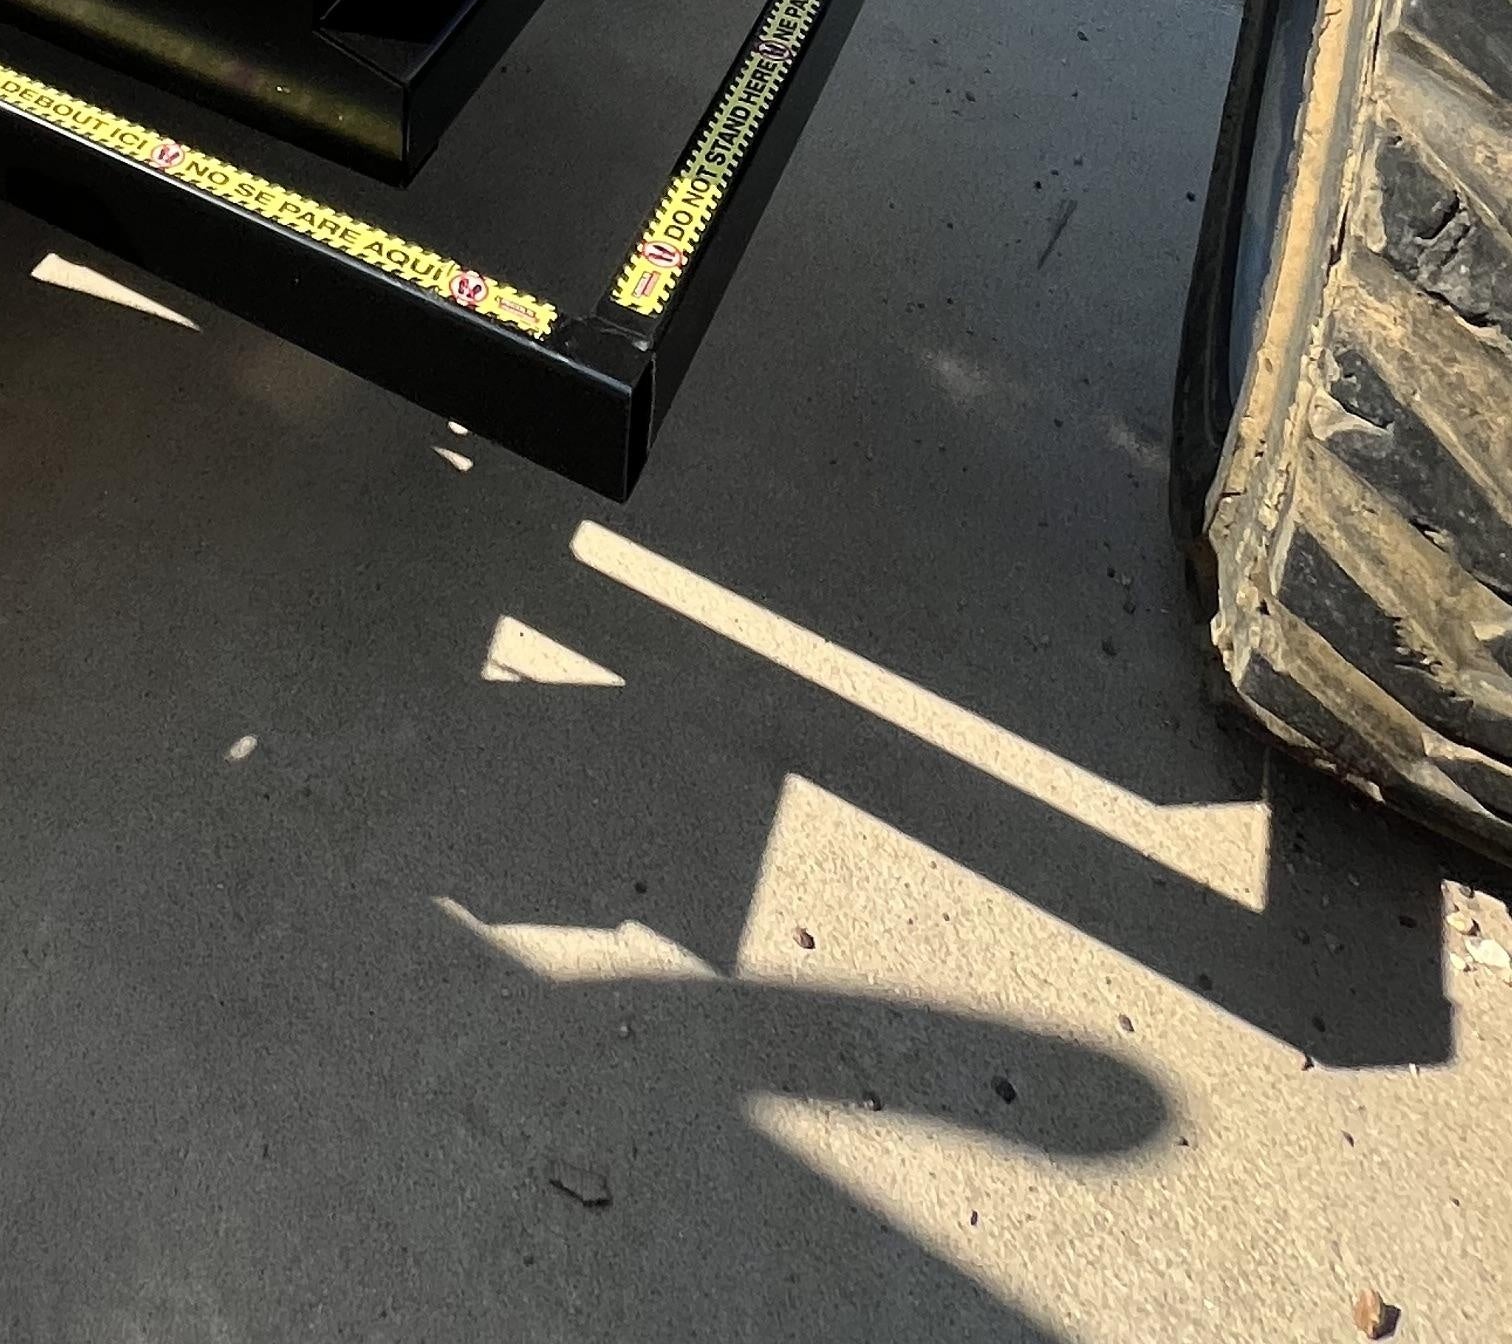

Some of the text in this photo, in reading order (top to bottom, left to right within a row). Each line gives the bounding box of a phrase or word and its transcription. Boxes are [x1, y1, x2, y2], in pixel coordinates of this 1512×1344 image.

[773, 18, 798, 41] NE
[0, 80, 110, 132] DEBOUT
[110, 126, 148, 151] ICI
[664, 59, 778, 242] DO NOT STAND HERE
[185, 160, 230, 186] NO
[234, 182, 275, 205] SE
[278, 200, 361, 244] PARE
